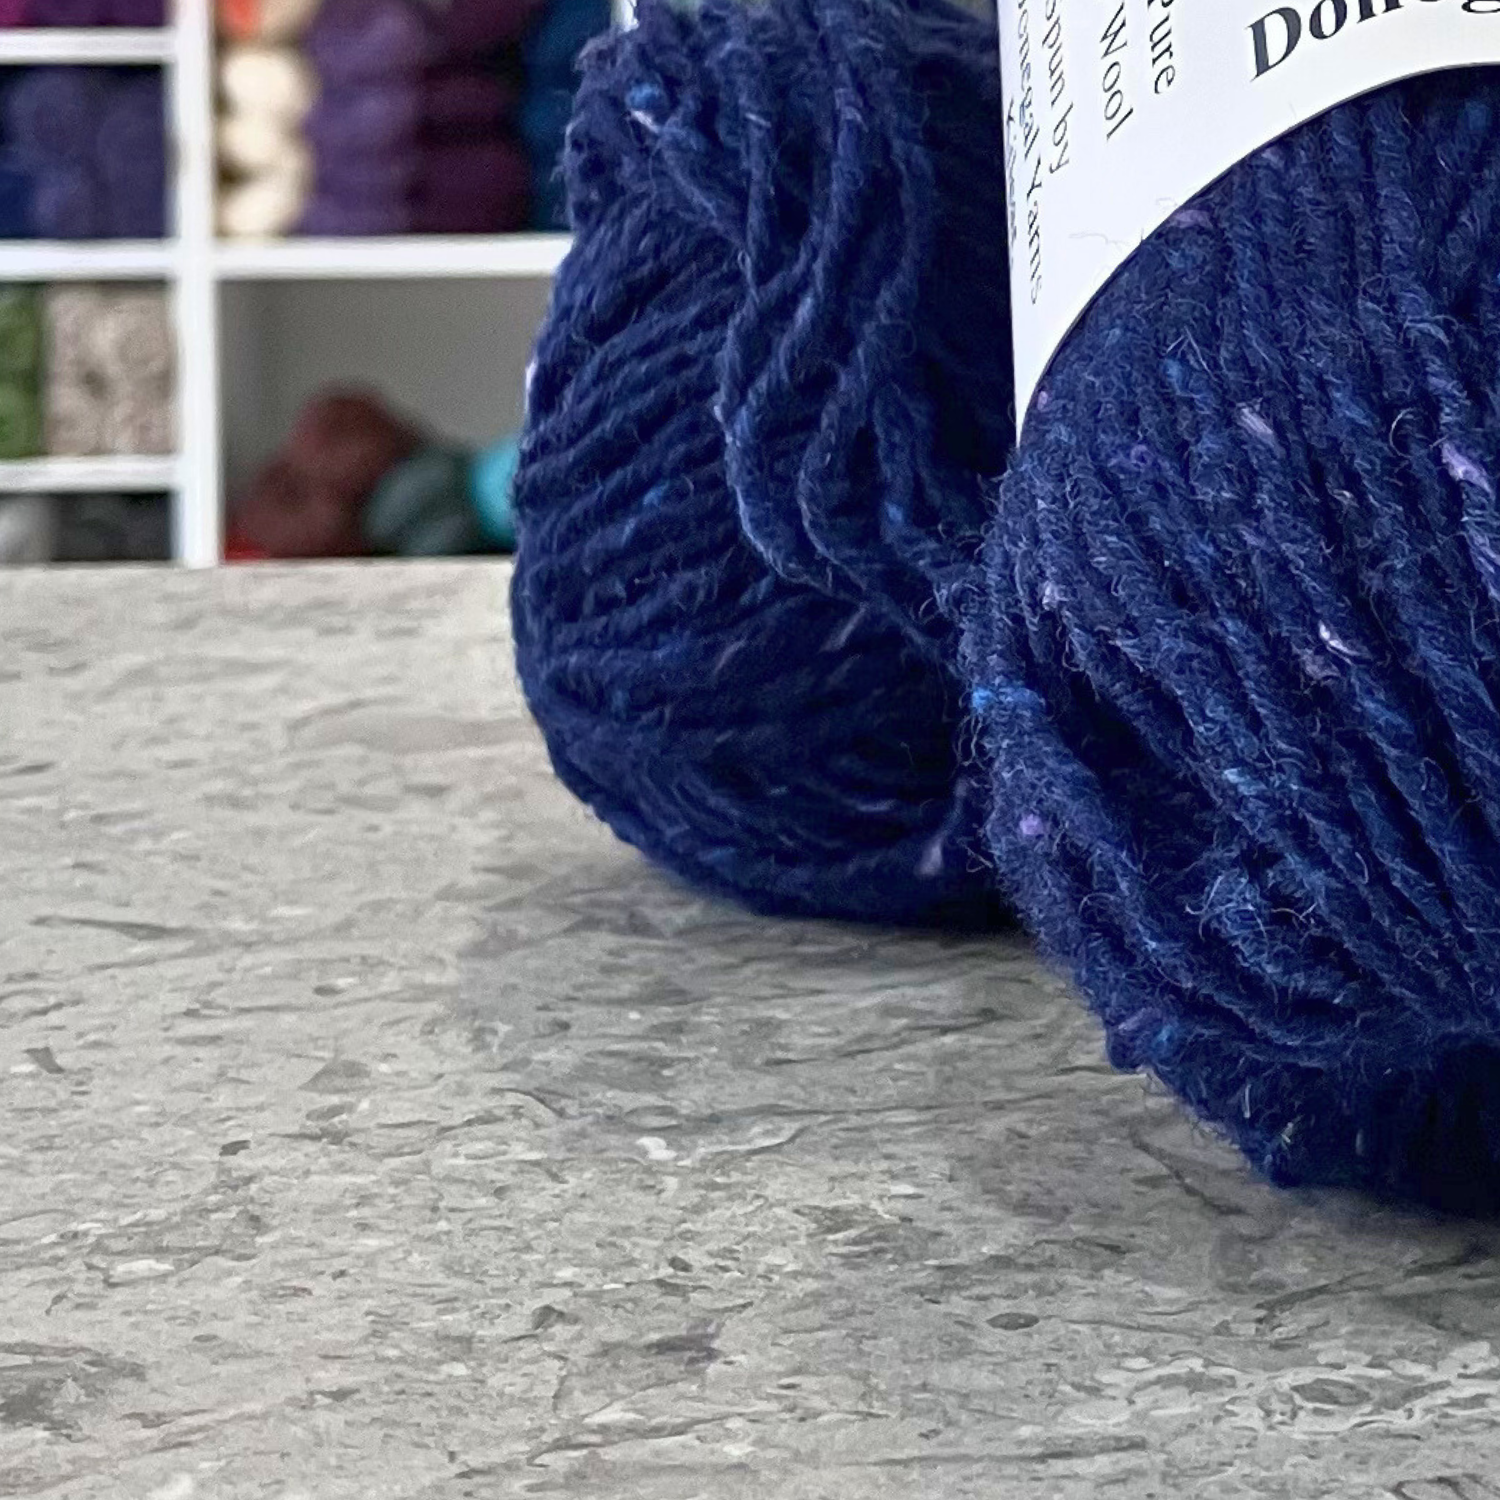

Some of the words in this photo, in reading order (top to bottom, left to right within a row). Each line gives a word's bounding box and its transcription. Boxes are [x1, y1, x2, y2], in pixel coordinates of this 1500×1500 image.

[1049, 101, 1074, 174] by
[1100, 0, 1134, 141] Wool
[1026, 154, 1042, 305] Yarns
